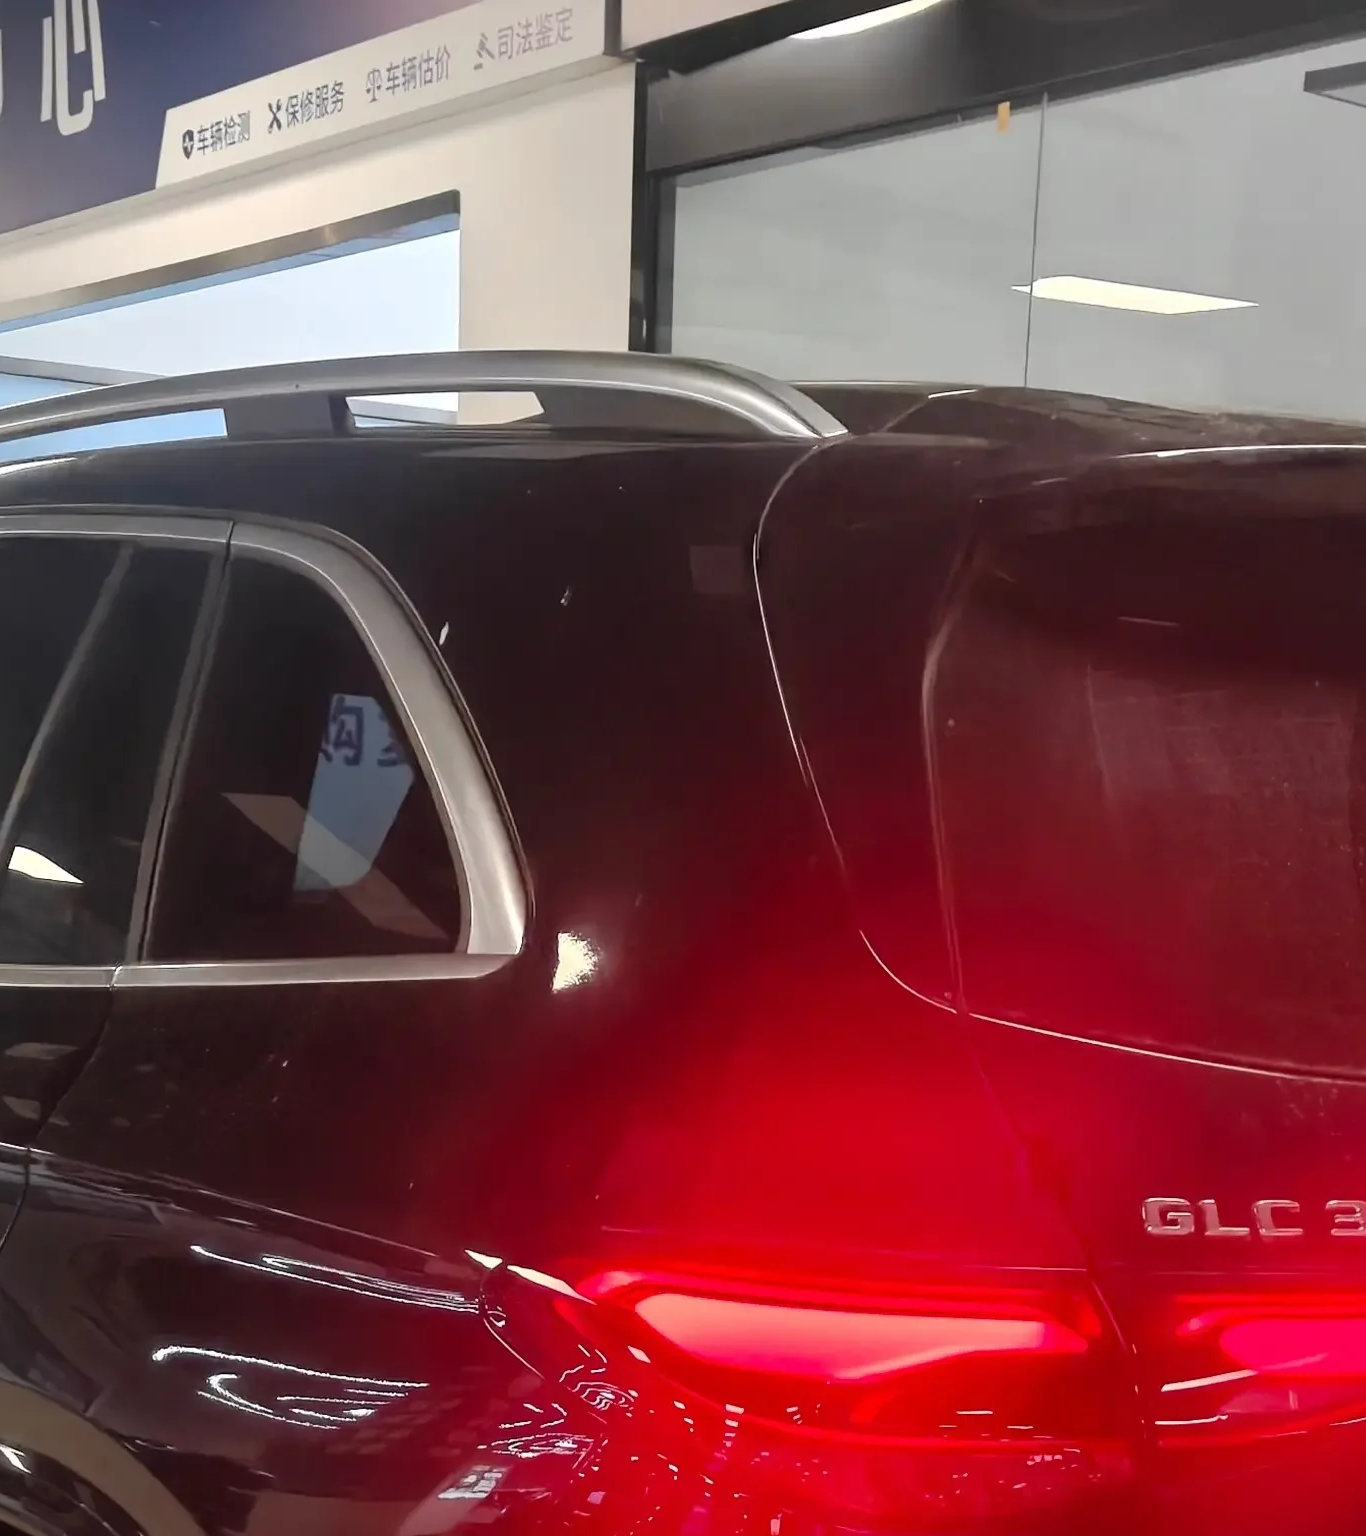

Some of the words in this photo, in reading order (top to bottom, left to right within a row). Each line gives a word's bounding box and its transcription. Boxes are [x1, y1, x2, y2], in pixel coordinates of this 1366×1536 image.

[197, 110, 251, 156] 车辆检测
[285, 80, 344, 128] 保修服务
[385, 45, 451, 96] 车辆估价
[497, 7, 573, 60] 司法鉴定
[1141, 1197, 1304, 1239] GLC
